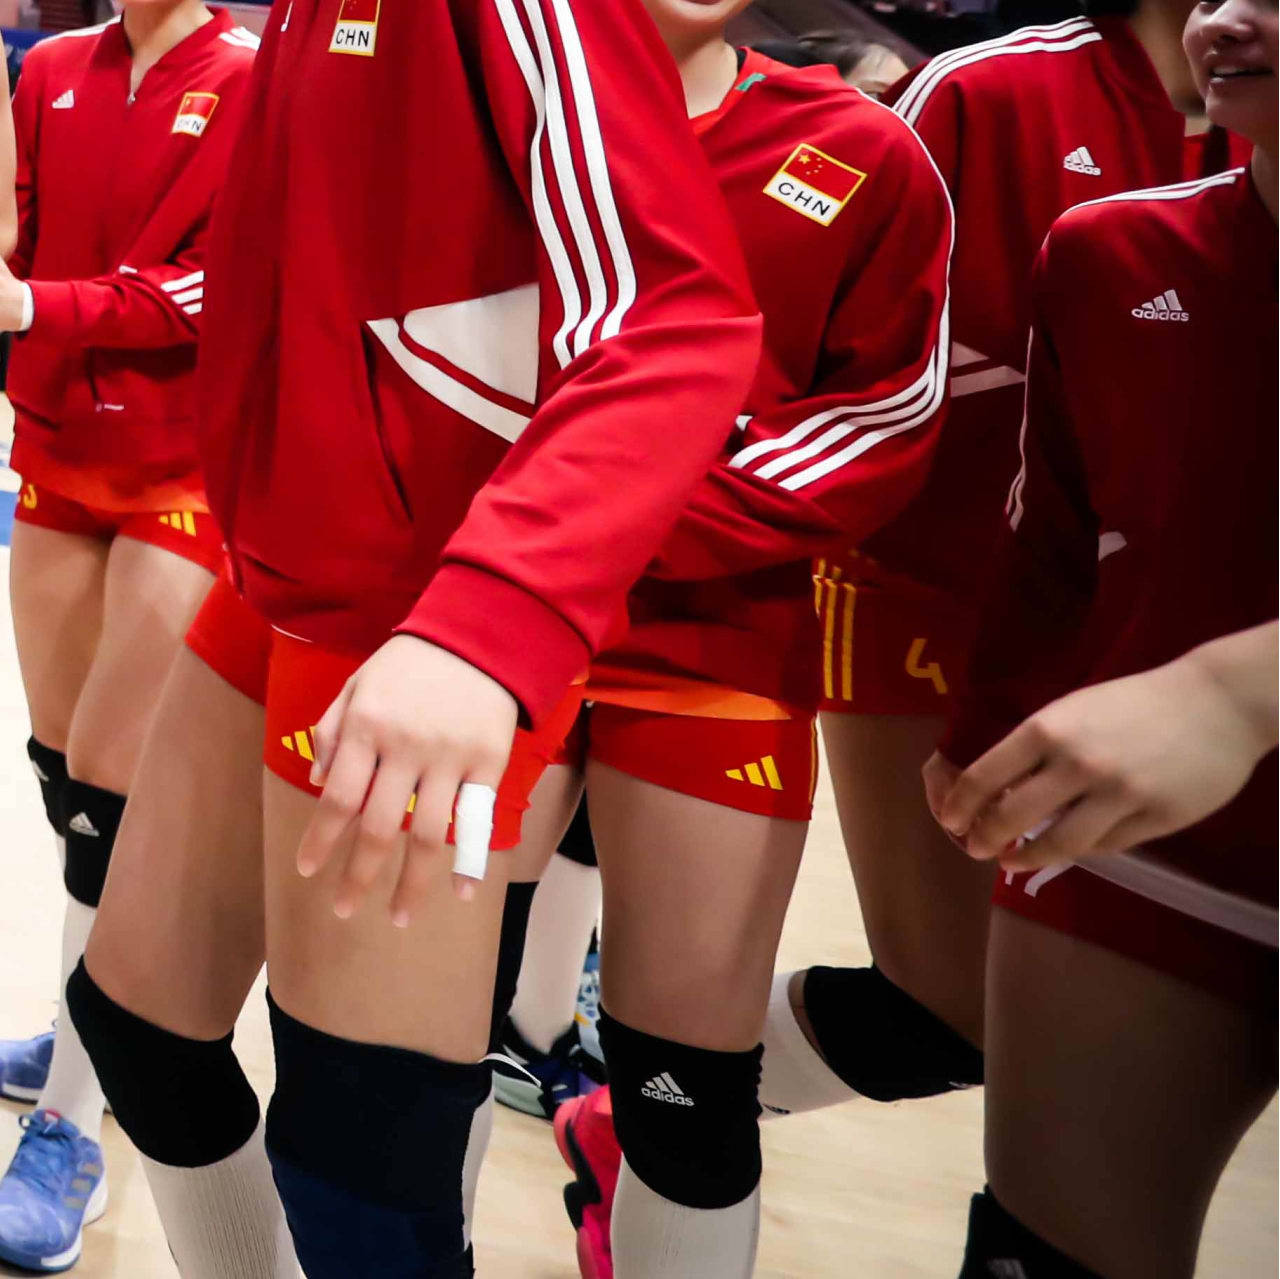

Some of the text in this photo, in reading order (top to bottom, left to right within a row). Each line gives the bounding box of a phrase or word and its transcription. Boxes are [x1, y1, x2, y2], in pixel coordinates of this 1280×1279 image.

[335, 28, 370, 47] CHN
[778, 182, 831, 216] CHN
[1131, 306, 1189, 322] adidas
[905, 638, 948, 695] 4
[640, 1086, 695, 1108] adidas
